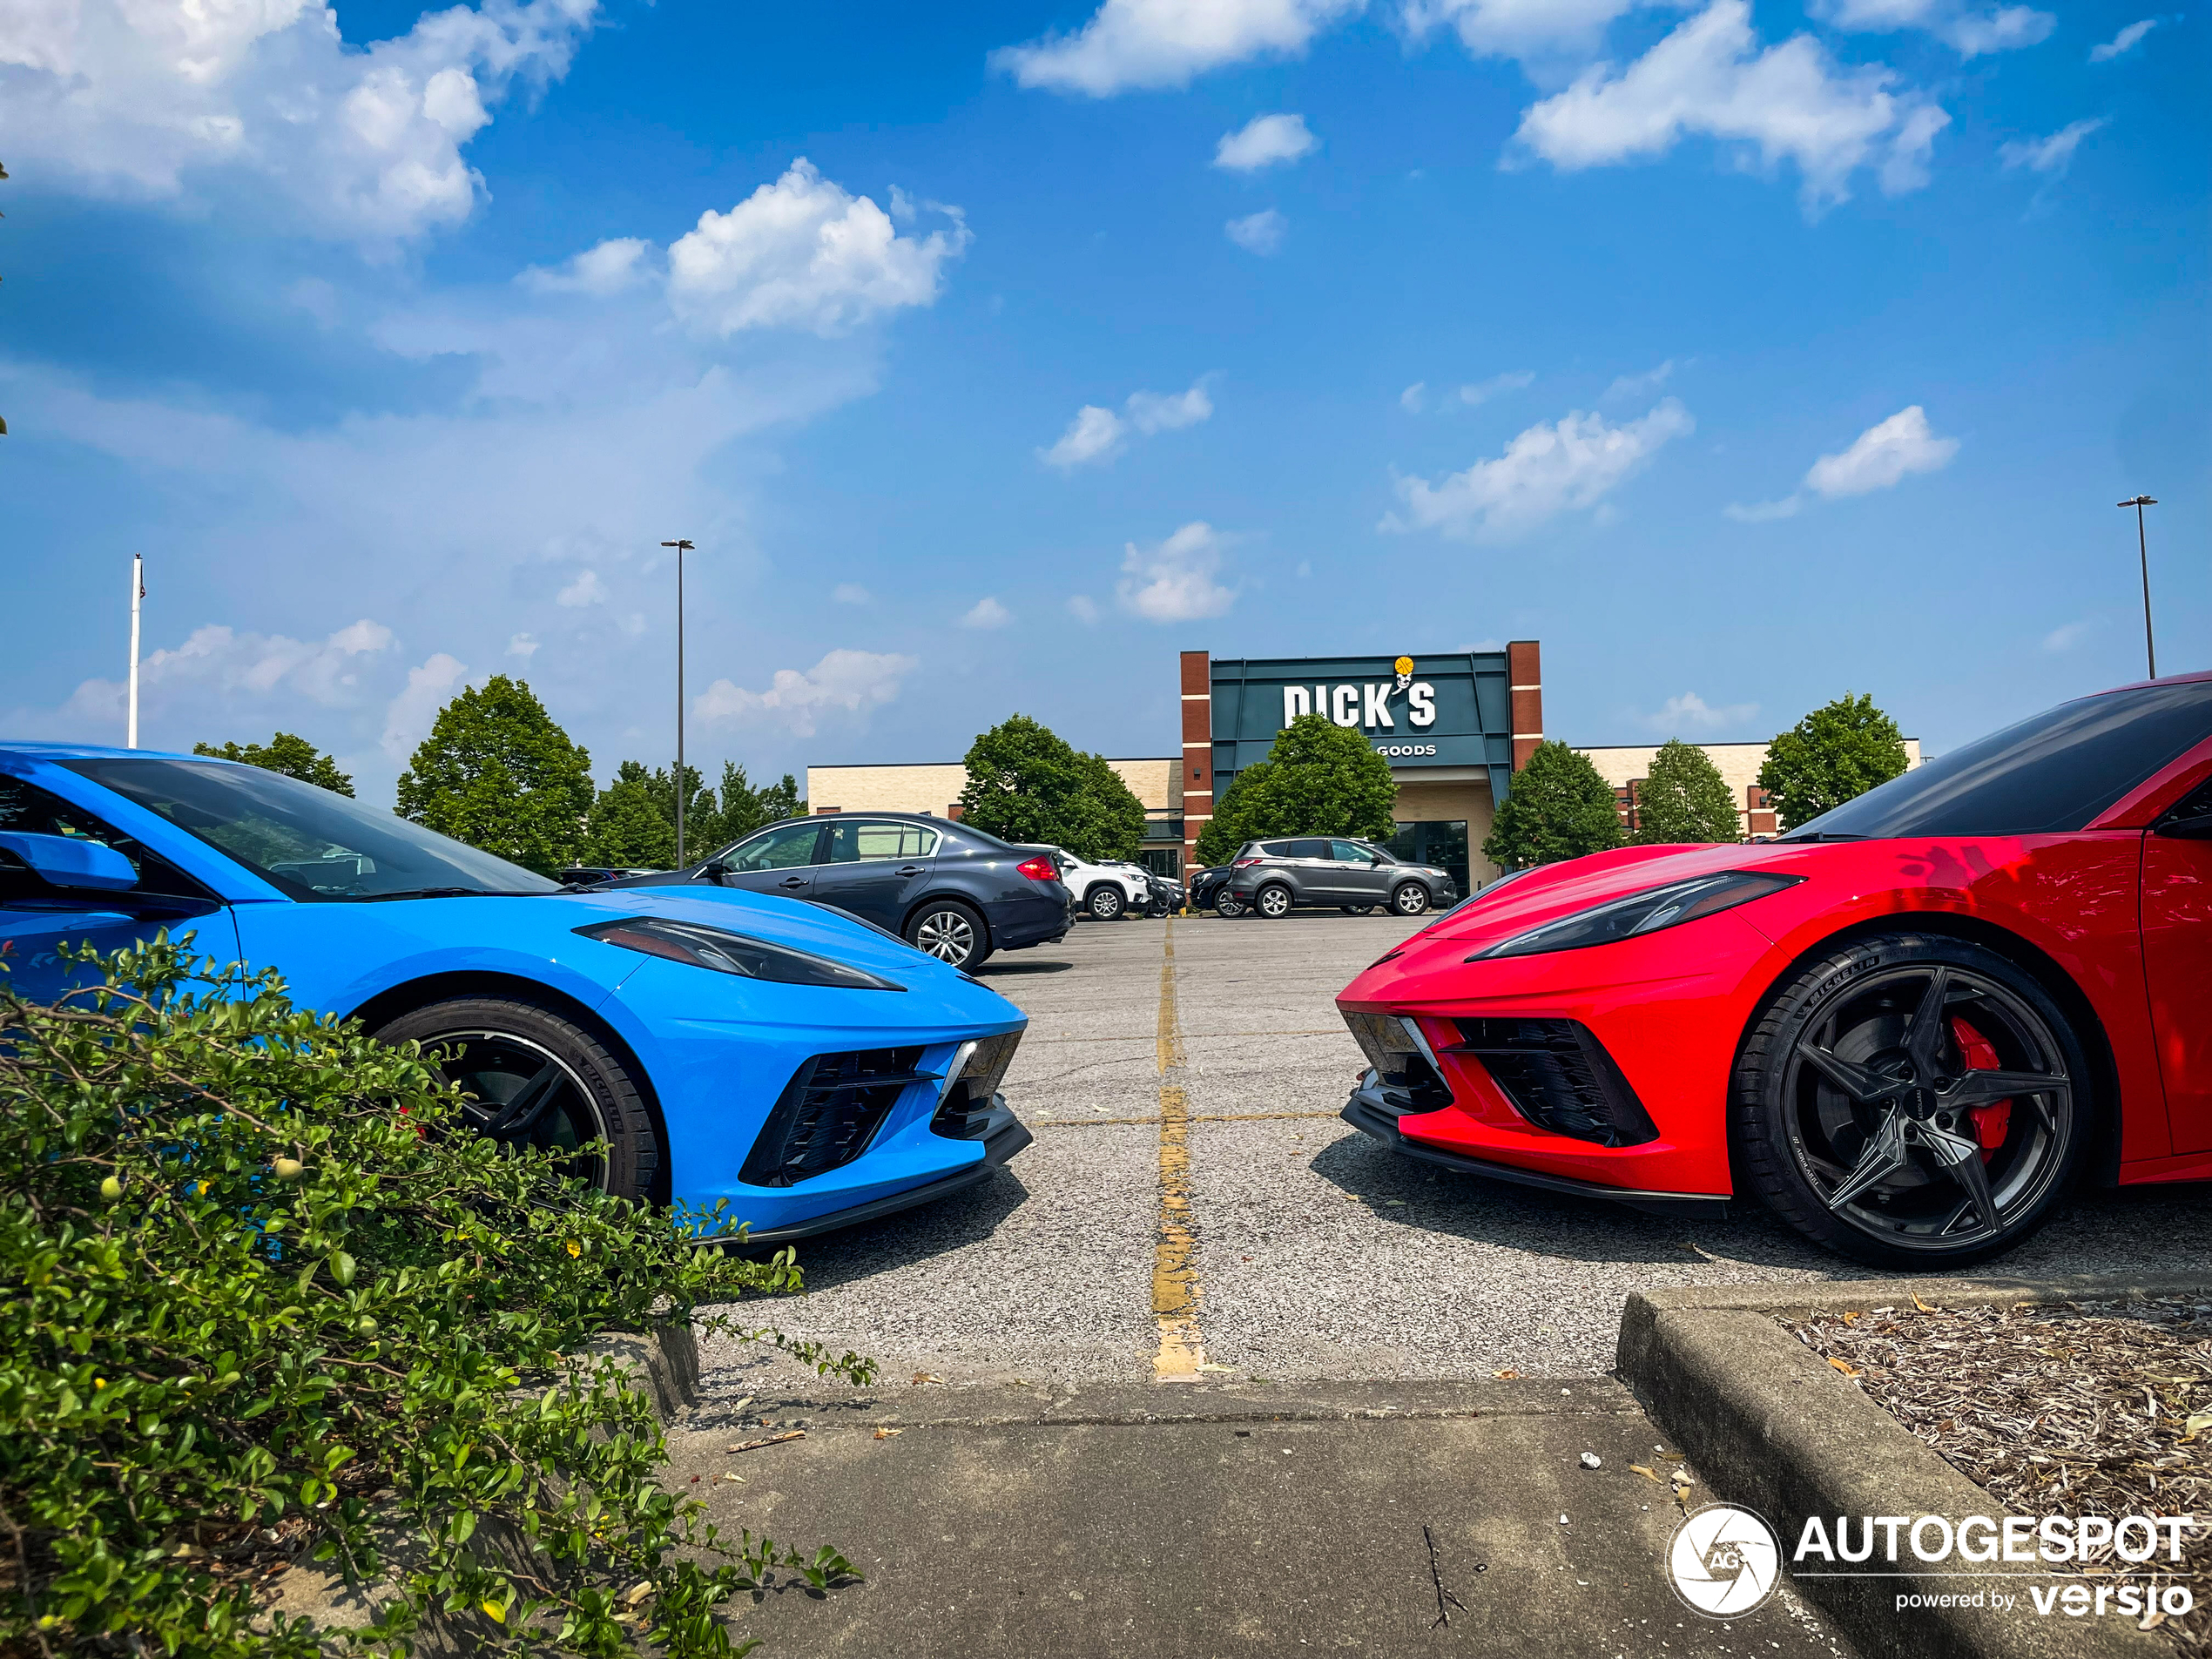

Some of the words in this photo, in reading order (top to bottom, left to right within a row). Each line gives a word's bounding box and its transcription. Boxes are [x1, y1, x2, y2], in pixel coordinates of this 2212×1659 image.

[1377, 745, 1437, 757] GOODS
[1809, 956, 1876, 1005] MICHELIN
[582, 1062, 624, 1131] MICHELIN
